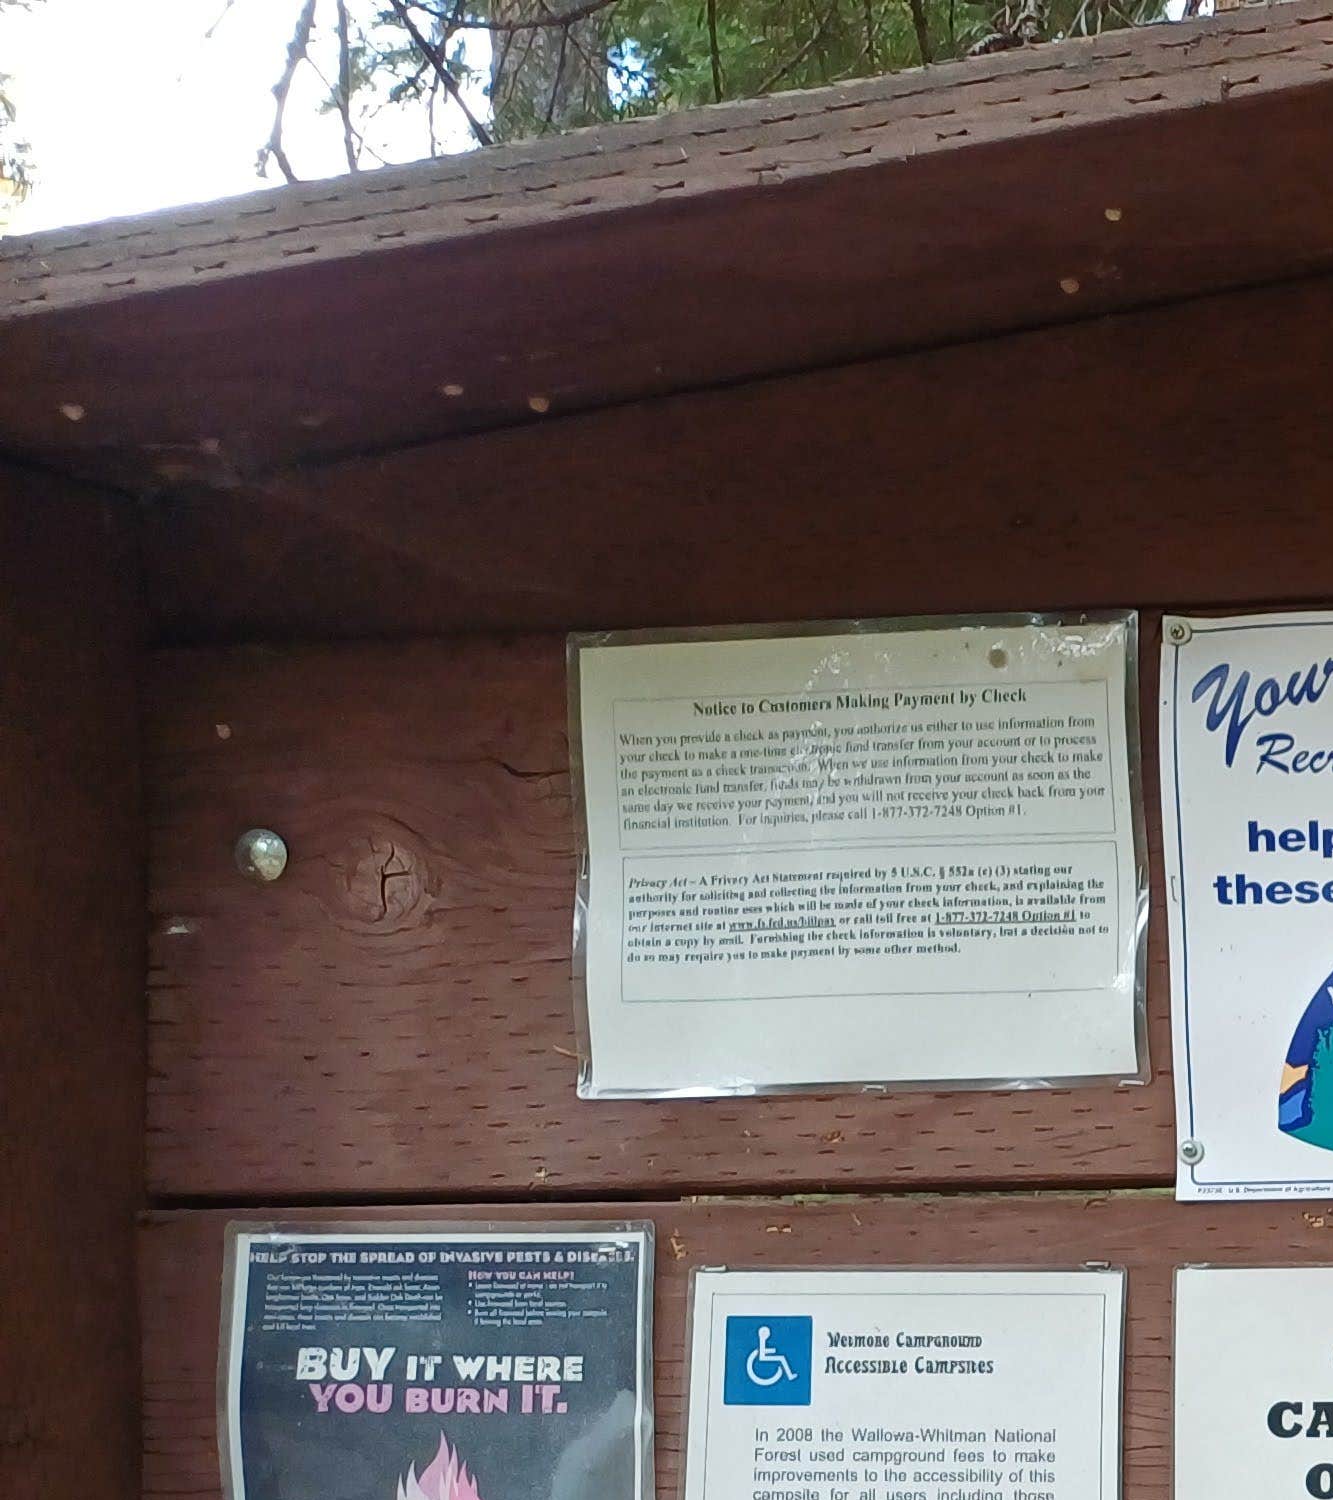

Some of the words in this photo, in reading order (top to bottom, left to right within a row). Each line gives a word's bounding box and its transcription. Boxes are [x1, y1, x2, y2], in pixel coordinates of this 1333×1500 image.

[694, 702, 736, 715] Notice
[742, 703, 754, 714] to
[759, 699, 831, 712] Customers
[837, 694, 889, 709] Making
[895, 693, 954, 709] Payment
[960, 690, 974, 707] by
[982, 688, 1026, 702] Check
[290, 1253, 326, 1264] STOP
[330, 1252, 356, 1263] THE
[360, 1252, 414, 1263] SPREAD
[419, 1252, 436, 1263] OF
[440, 1251, 503, 1262] INVASIVE
[507, 1251, 550, 1262] PESTS
[554, 1252, 563, 1262] &
[296, 1348, 395, 1380] BUY
[407, 1356, 441, 1380] IT
[453, 1356, 583, 1381] WHERE
[309, 1383, 392, 1412] YOU
[406, 1387, 507, 1413] BURN
[522, 1383, 567, 1413] IT.
[756, 1428, 768, 1442] In
[777, 1428, 812, 1441] 2008
[821, 1428, 843, 1442] the
[852, 1428, 986, 1442] Wallowa-Whitman
[995, 1429, 1055, 1442] National
[755, 1448, 800, 1461] Forest
[810, 1448, 844, 1462] used
[853, 1448, 944, 1465] campground
[954, 1448, 984, 1462] fees
[993, 1450, 1006, 1462] to
[1015, 1449, 1055, 1462] make
